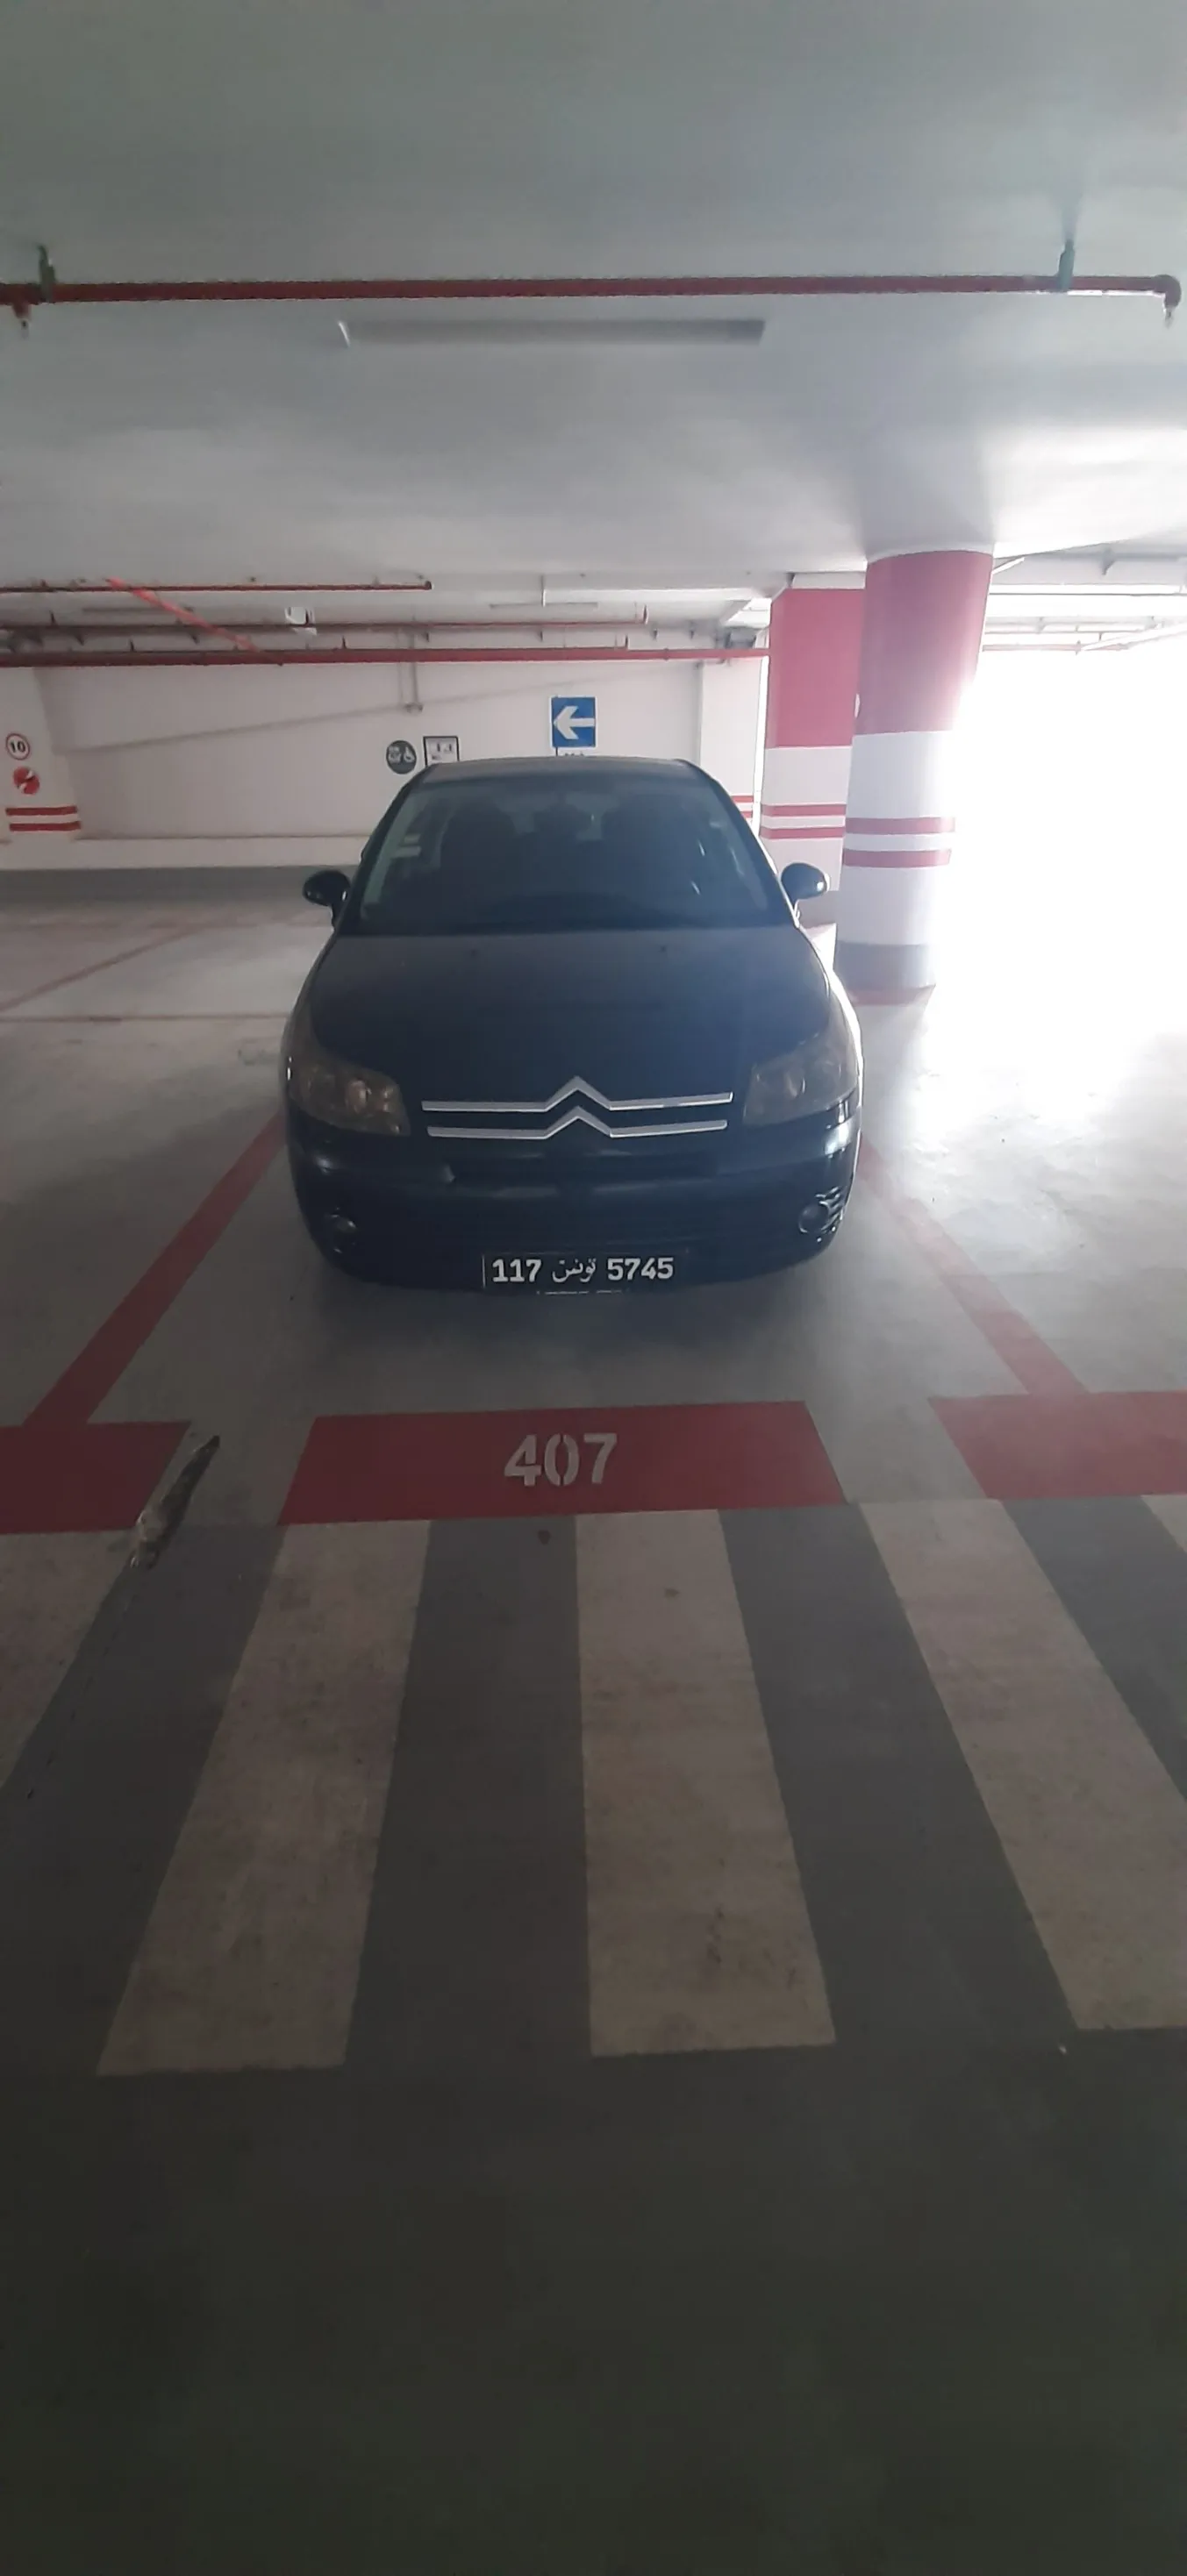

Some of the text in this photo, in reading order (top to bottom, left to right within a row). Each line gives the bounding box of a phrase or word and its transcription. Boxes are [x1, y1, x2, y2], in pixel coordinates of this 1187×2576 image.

[11, 740, 26, 753] 10
[491, 1257, 675, 1283] 117 تونس 5745
[504, 1433, 618, 1487] 407
